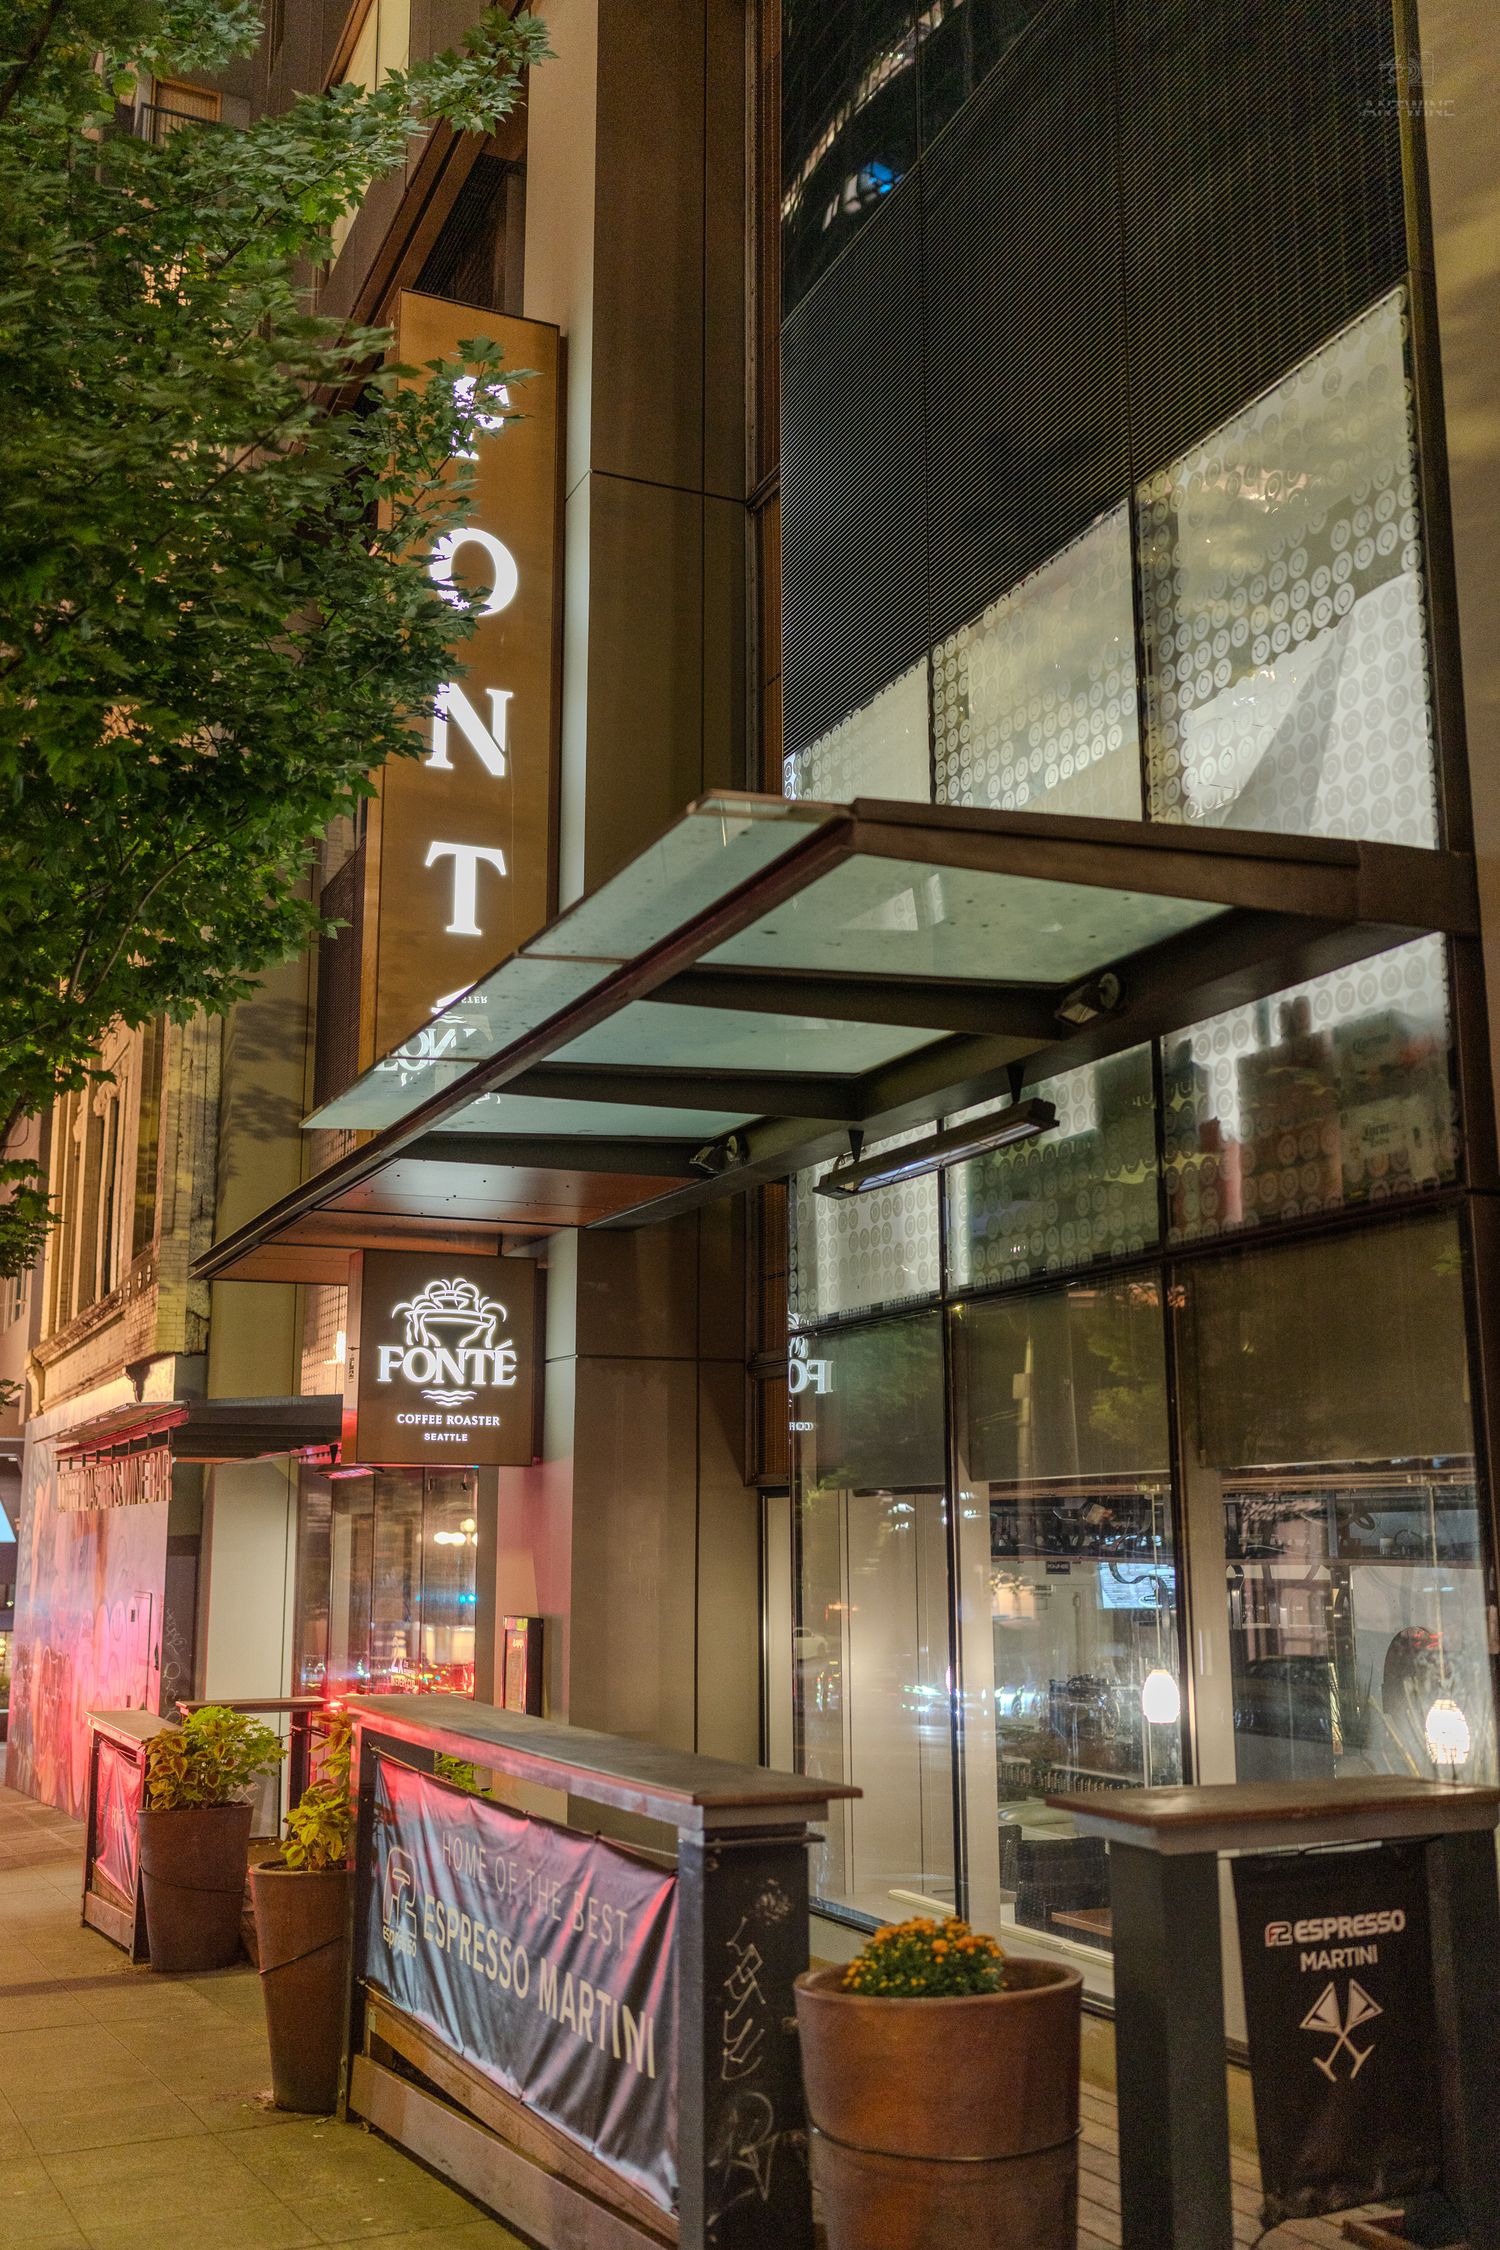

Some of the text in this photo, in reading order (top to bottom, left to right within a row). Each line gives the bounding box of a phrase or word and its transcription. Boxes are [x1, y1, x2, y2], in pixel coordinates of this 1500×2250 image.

[376, 1339, 517, 1386] FONTÉ
[397, 1414, 501, 1427] COFFEE ROASTER
[424, 1432, 468, 1442] SEATTLE
[442, 1831, 628, 1950] HOME OF THE BEST
[1293, 1909, 1407, 1944] ESPRESSO
[1299, 1943, 1379, 1973] MARTINI
[423, 1894, 530, 1999] ESPRESSO
[539, 1957, 656, 2079] MARTINI
